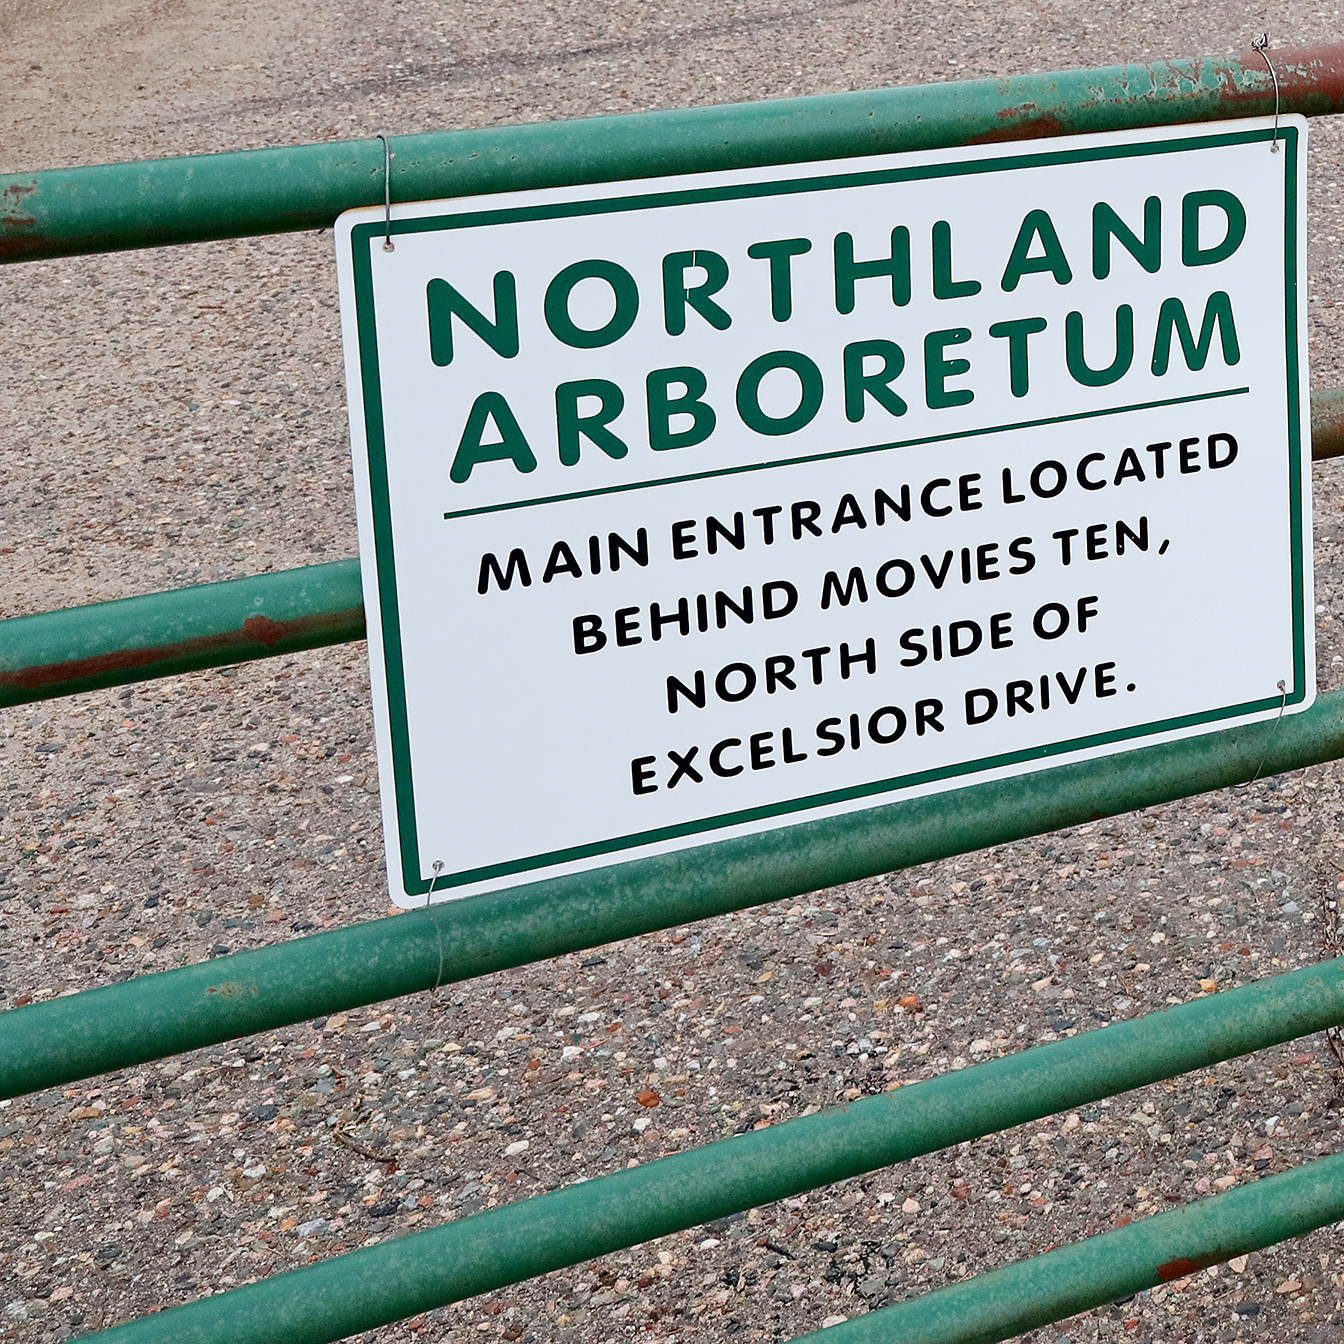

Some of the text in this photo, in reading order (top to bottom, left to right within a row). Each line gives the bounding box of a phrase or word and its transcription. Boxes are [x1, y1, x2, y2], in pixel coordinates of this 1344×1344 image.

[426, 188, 1248, 367] NORTHLAND
[448, 290, 1242, 484] ARBORETUM
[476, 432, 1239, 595] MAIN ENTRANCE LOCATED
[572, 515, 1171, 654] BEHIND MOVIES TEN,
[630, 661, 1137, 795] EXCELSIOR DRIVE.
[666, 595, 1100, 713] NORTH SIDE OF
